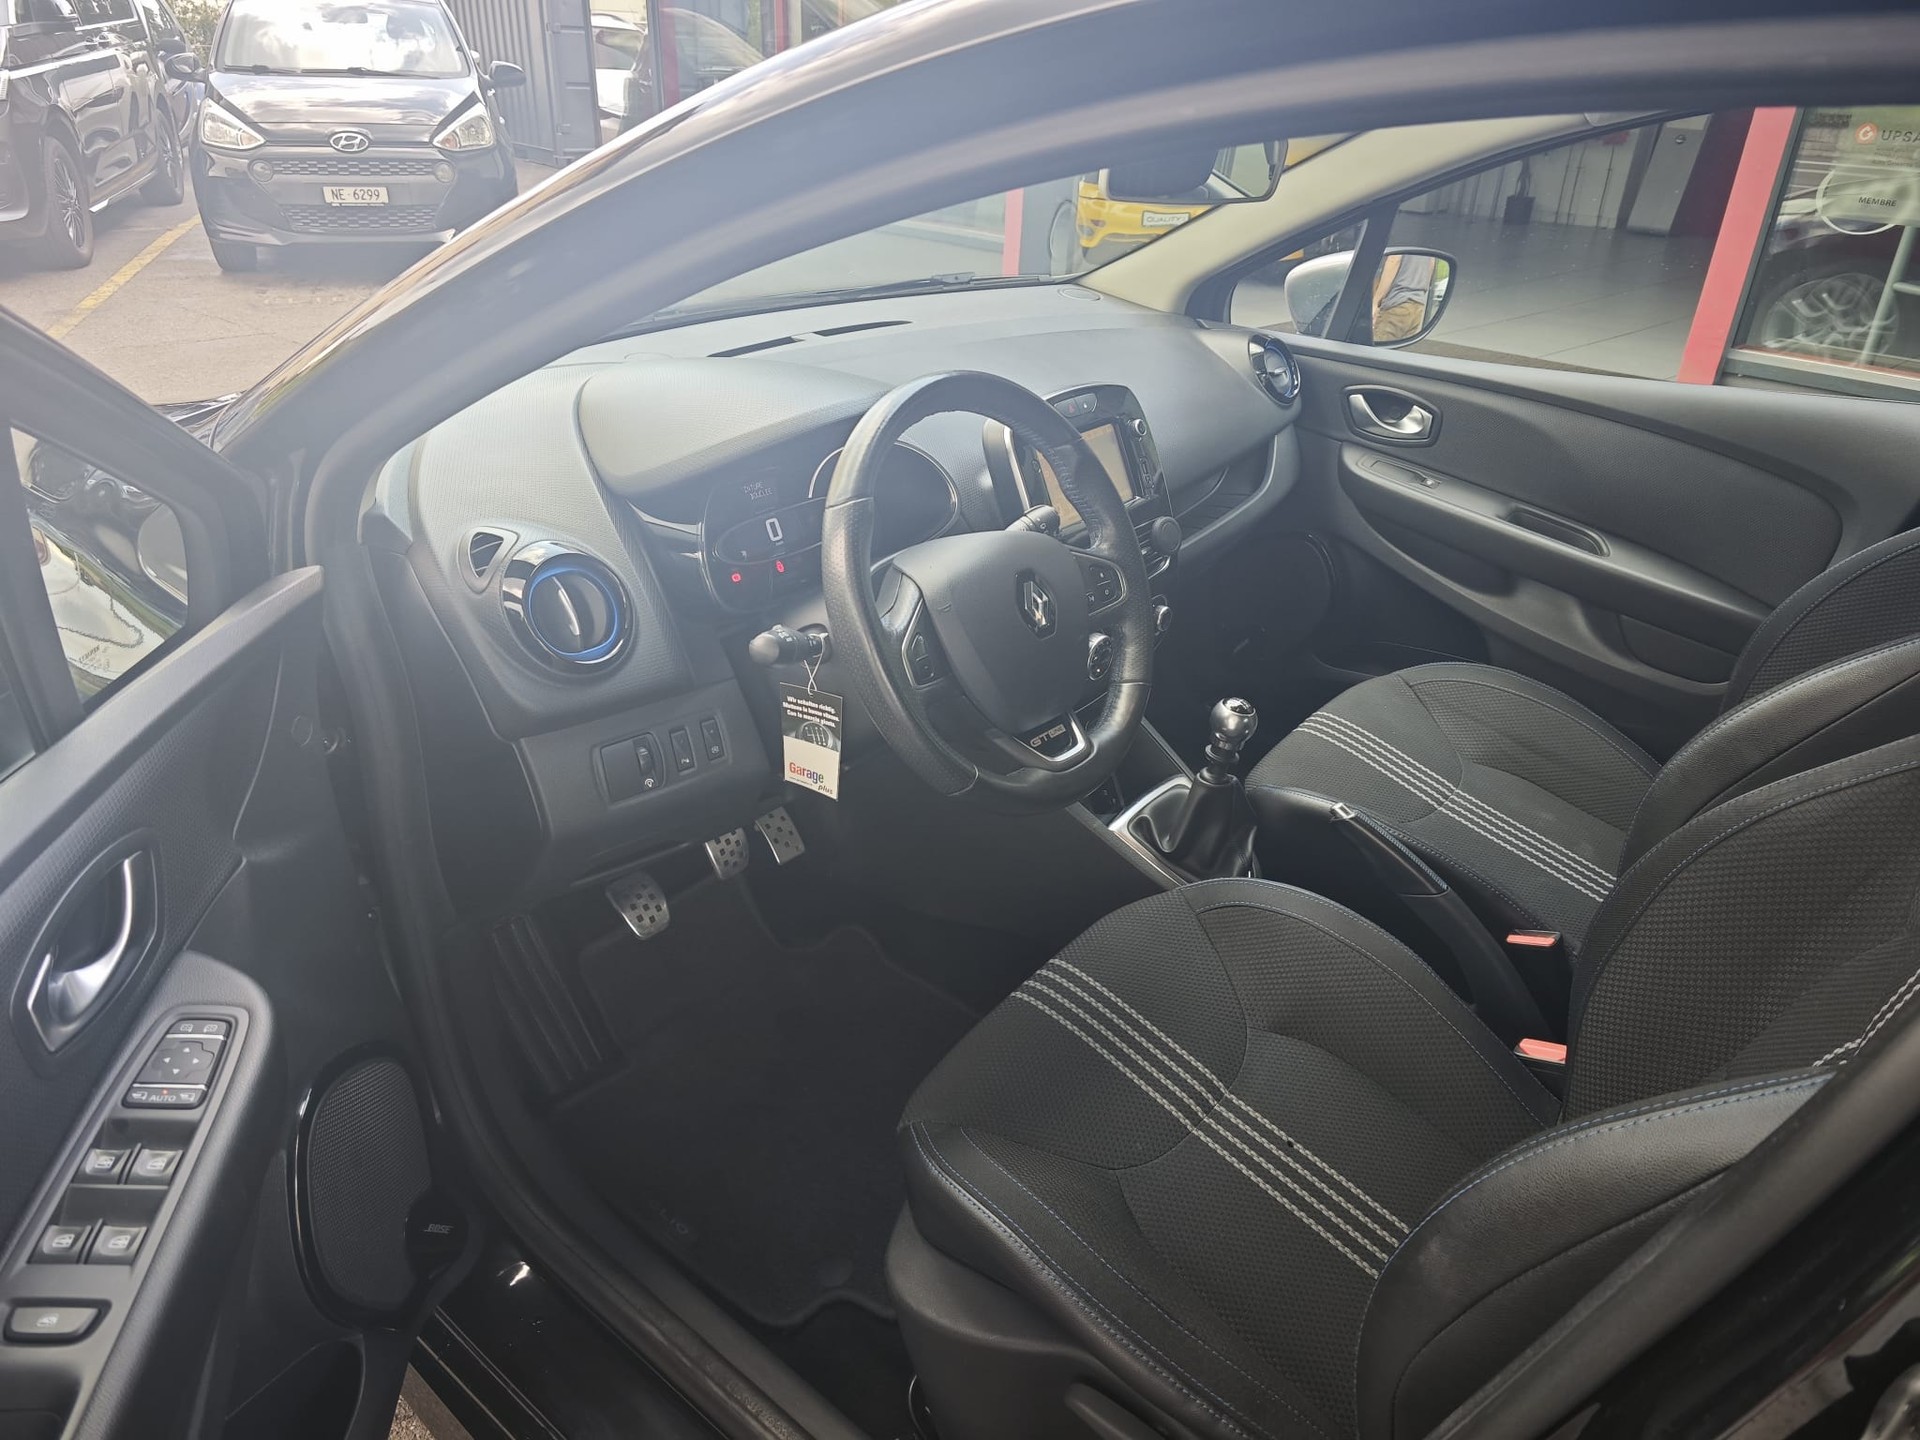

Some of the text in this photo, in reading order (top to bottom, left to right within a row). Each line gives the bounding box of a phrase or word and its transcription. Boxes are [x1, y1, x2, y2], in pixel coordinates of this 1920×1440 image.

[331, 189, 380, 201] NE 6299
[1858, 196, 1897, 207] MEMBRE
[765, 518, 783, 542] 0
[789, 762, 824, 785] Garage
[818, 785, 833, 795] plus
[148, 1094, 177, 1102] AUTO
